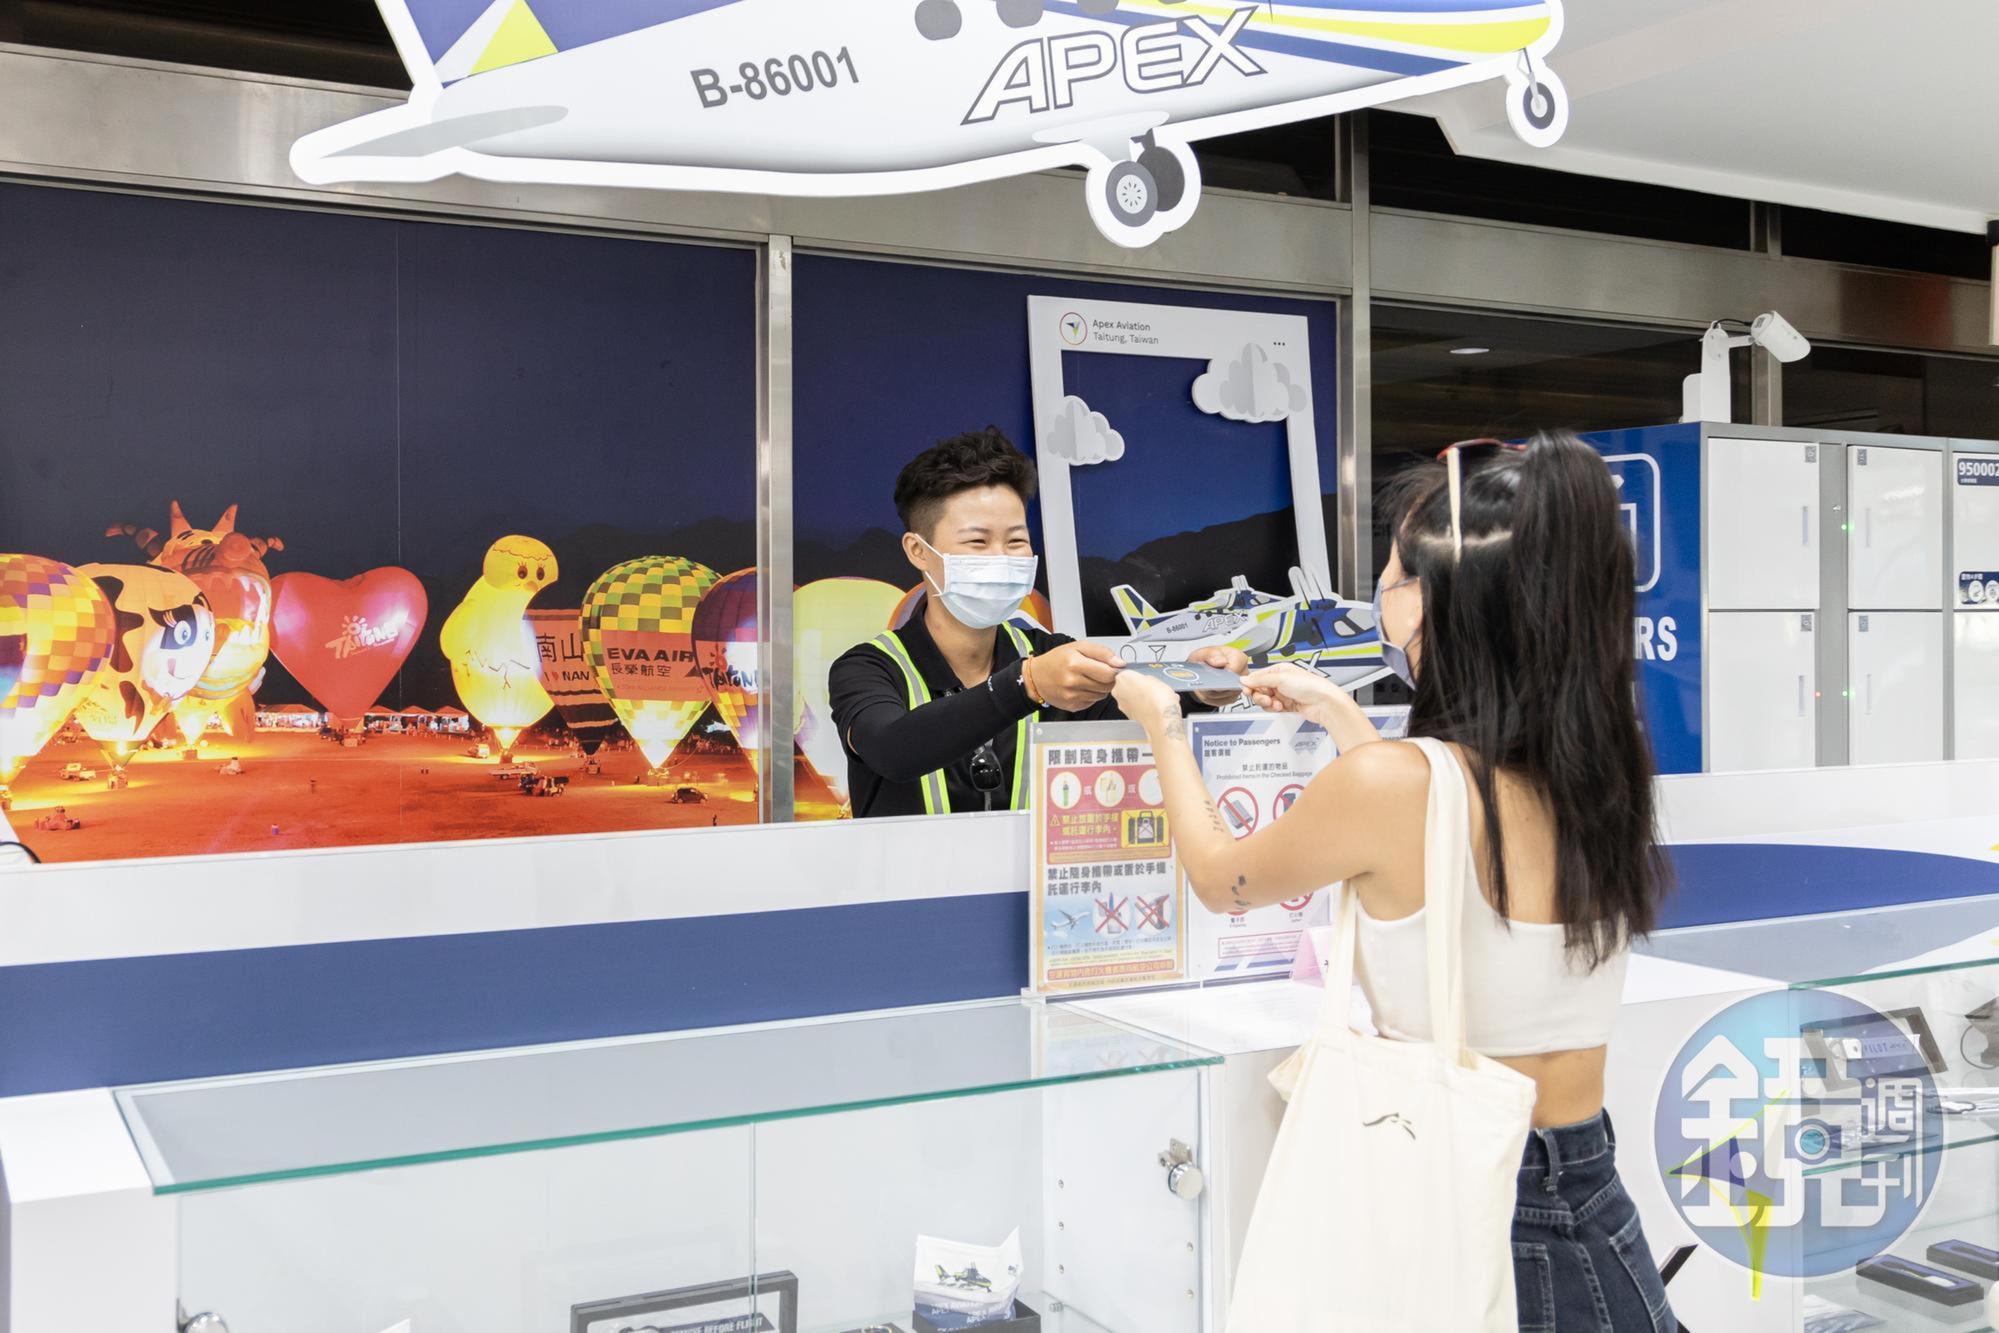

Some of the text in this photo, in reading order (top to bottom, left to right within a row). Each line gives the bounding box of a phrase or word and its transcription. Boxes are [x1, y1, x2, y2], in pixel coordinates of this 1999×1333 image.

[961, 5, 1267, 125] APEX
[690, 46, 859, 108] B-86001
[1093, 319, 1151, 331] Apex Aviation
[1093, 332, 1159, 344] Taitung, Taiwan
[607, 648, 696, 663] EVA AIR
[611, 663, 671, 678] 長榮航空
[1238, 738, 1281, 747] Passengers
